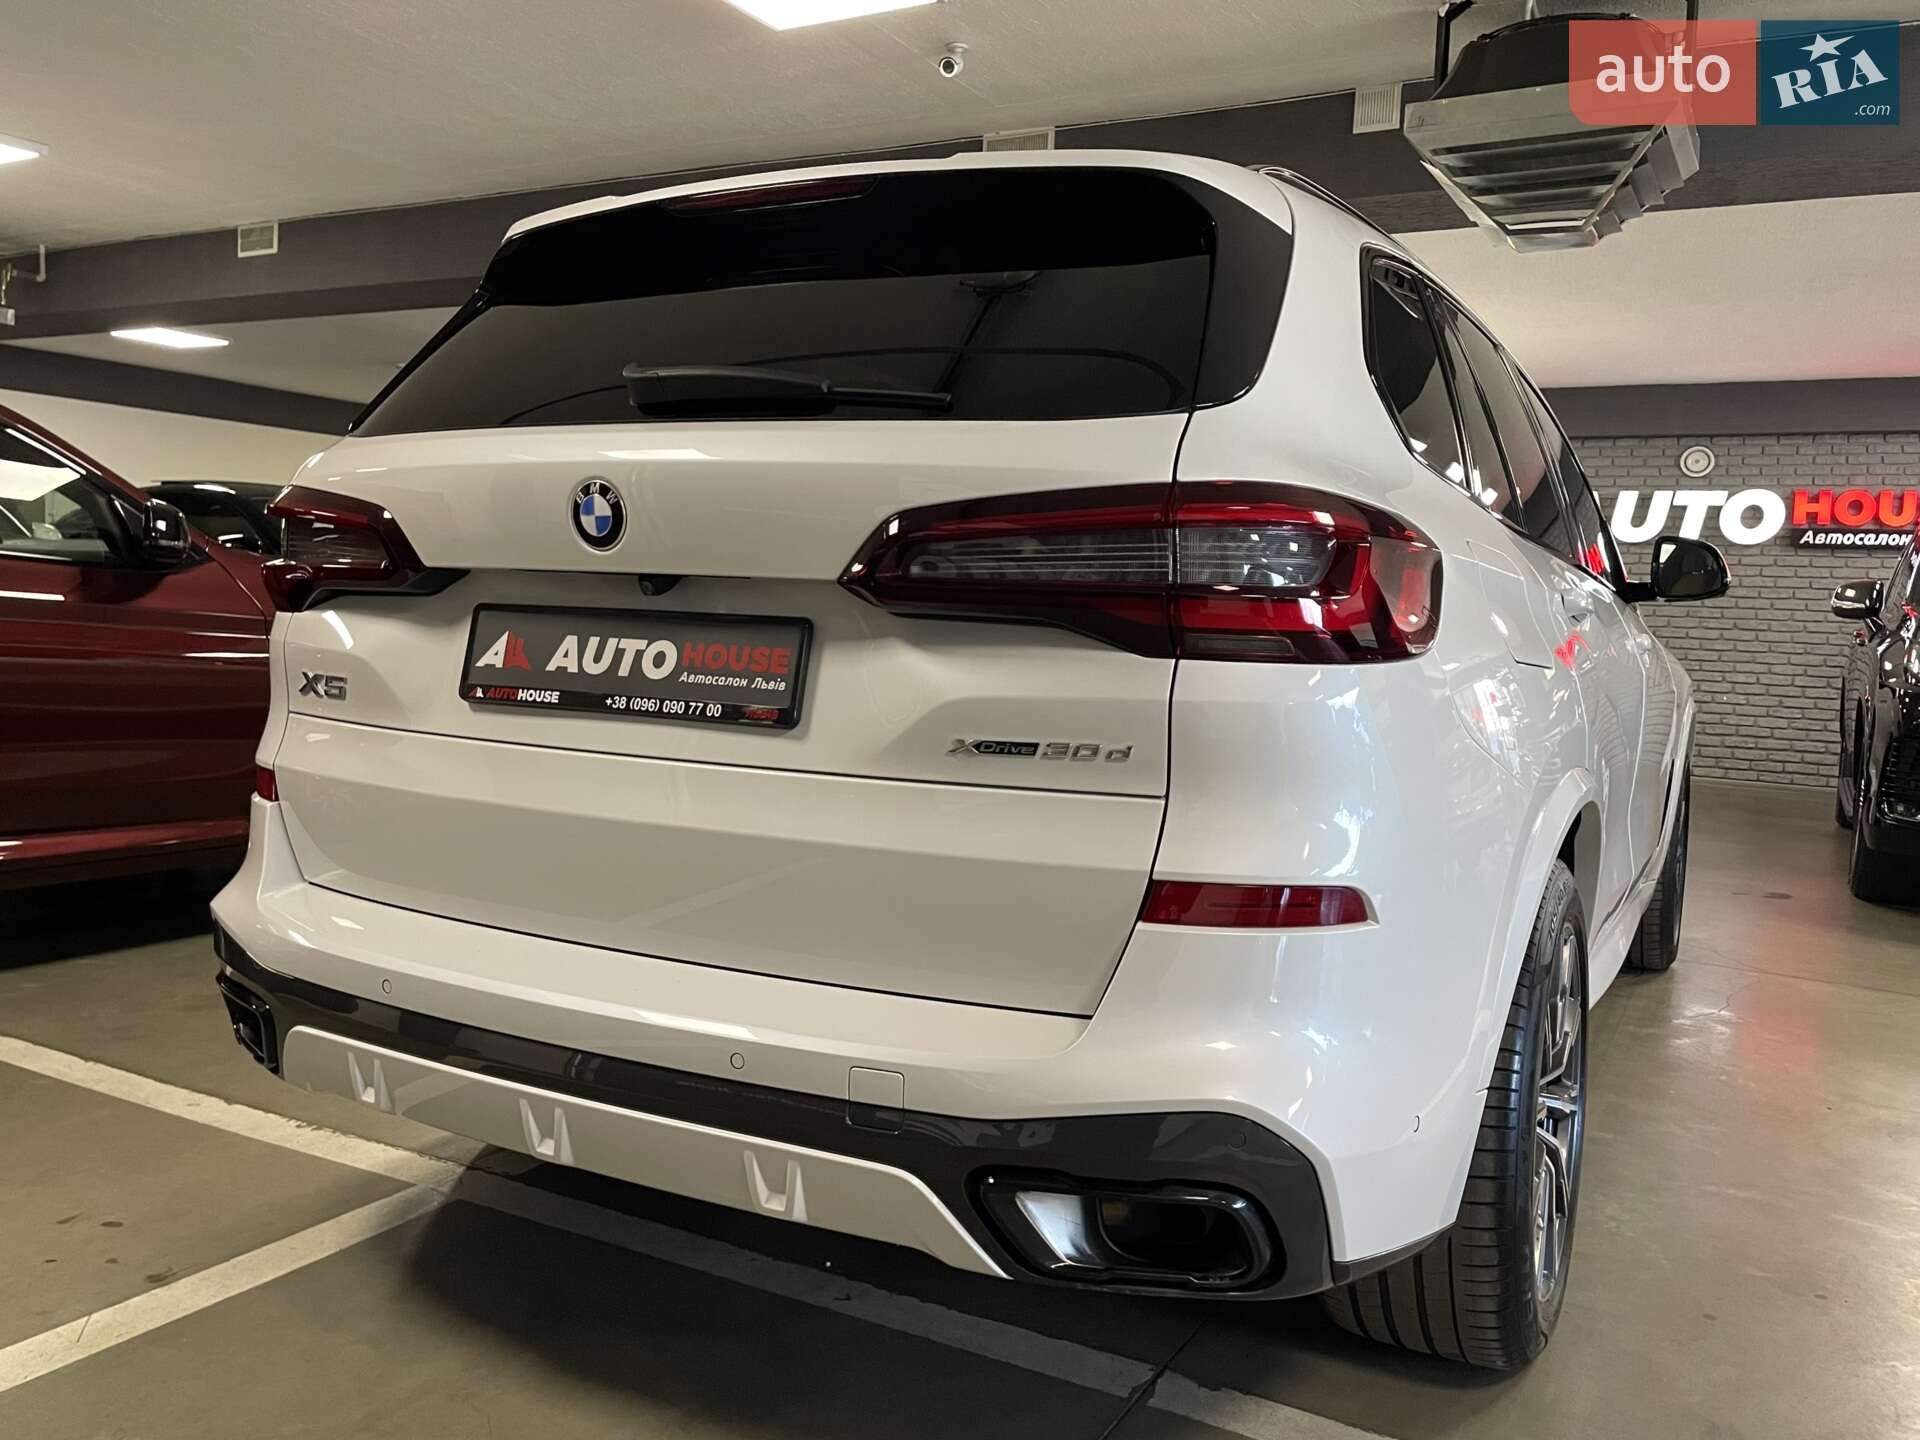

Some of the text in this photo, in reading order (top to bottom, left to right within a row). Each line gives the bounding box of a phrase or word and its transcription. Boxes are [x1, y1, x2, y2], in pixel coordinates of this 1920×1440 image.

[576, 482, 618, 505] BMW
[1592, 489, 1920, 545] UTO HOU
[1799, 530, 1914, 546] Автосалон
[545, 635, 792, 680] AUTO HOUSE
[299, 671, 348, 701] X5
[678, 671, 787, 691] Автосалон Львів
[605, 696, 722, 717] +38 (096) 090 77 00
